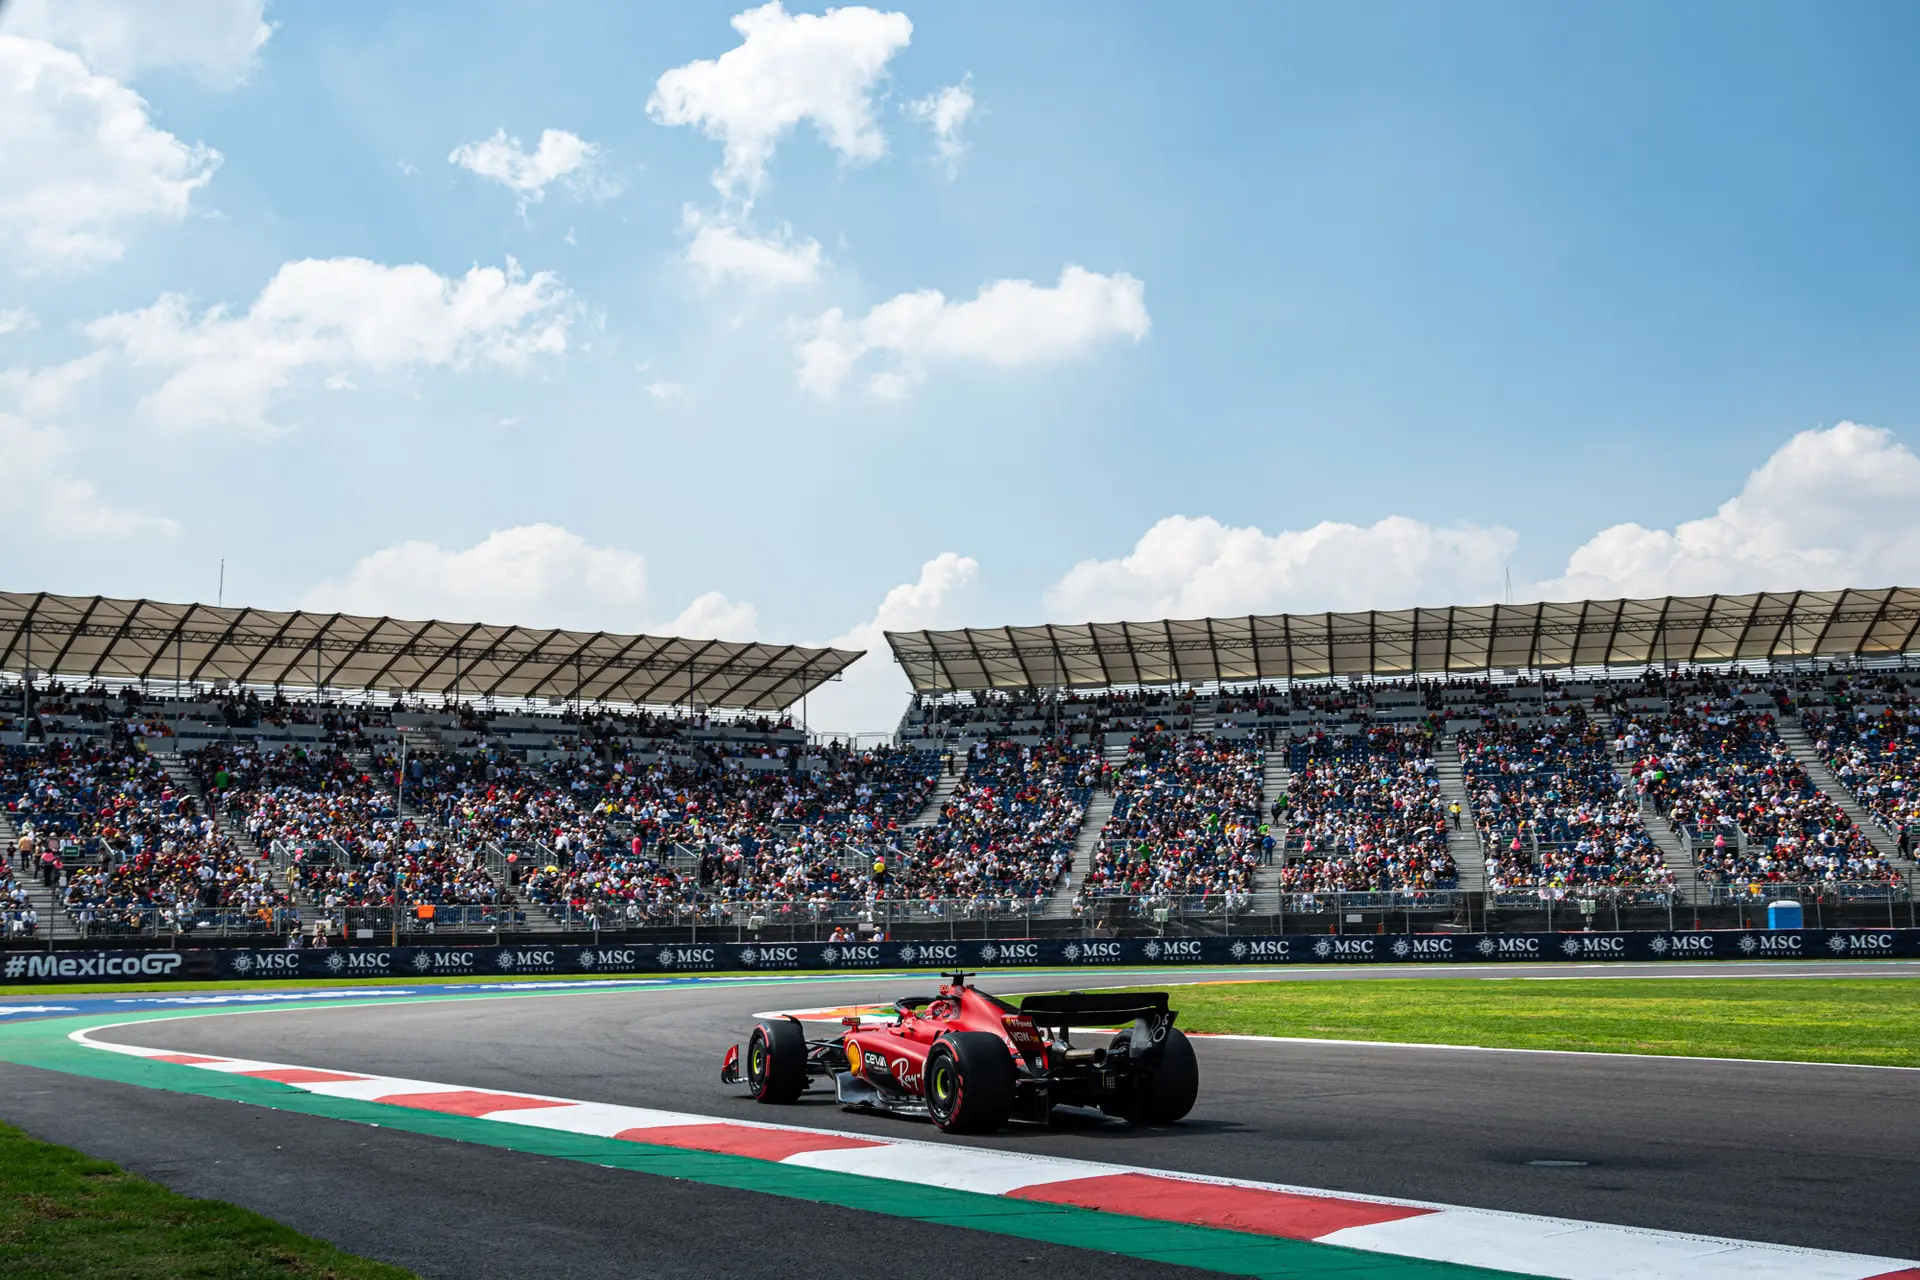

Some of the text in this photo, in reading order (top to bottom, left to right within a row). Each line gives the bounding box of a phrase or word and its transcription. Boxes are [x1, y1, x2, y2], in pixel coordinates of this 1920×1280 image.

[1164, 941, 1201, 955] MSC
[1250, 940, 1289, 955] MSC
[1334, 939, 1374, 953] MSC
[1413, 938, 1452, 953] MSC
[1498, 938, 1539, 952] MSC
[1583, 937, 1624, 951] MSC
[1671, 935, 1713, 950] MSC
[1760, 935, 1801, 949] MSC
[1850, 934, 1892, 948] MSC
[677, 948, 714, 963] MSC
[760, 947, 798, 961] MSC
[841, 946, 879, 960] MSC
[919, 945, 957, 959] MSC
[1000, 944, 1038, 958] MSC
[1082, 942, 1121, 956] MSC
[256, 953, 299, 968] MSC
[349, 952, 390, 967] MSC
[434, 952, 473, 966] MSC
[517, 951, 554, 965] MSC
[598, 950, 635, 964] MSC
[4, 953, 182, 978] #MexicoGP
